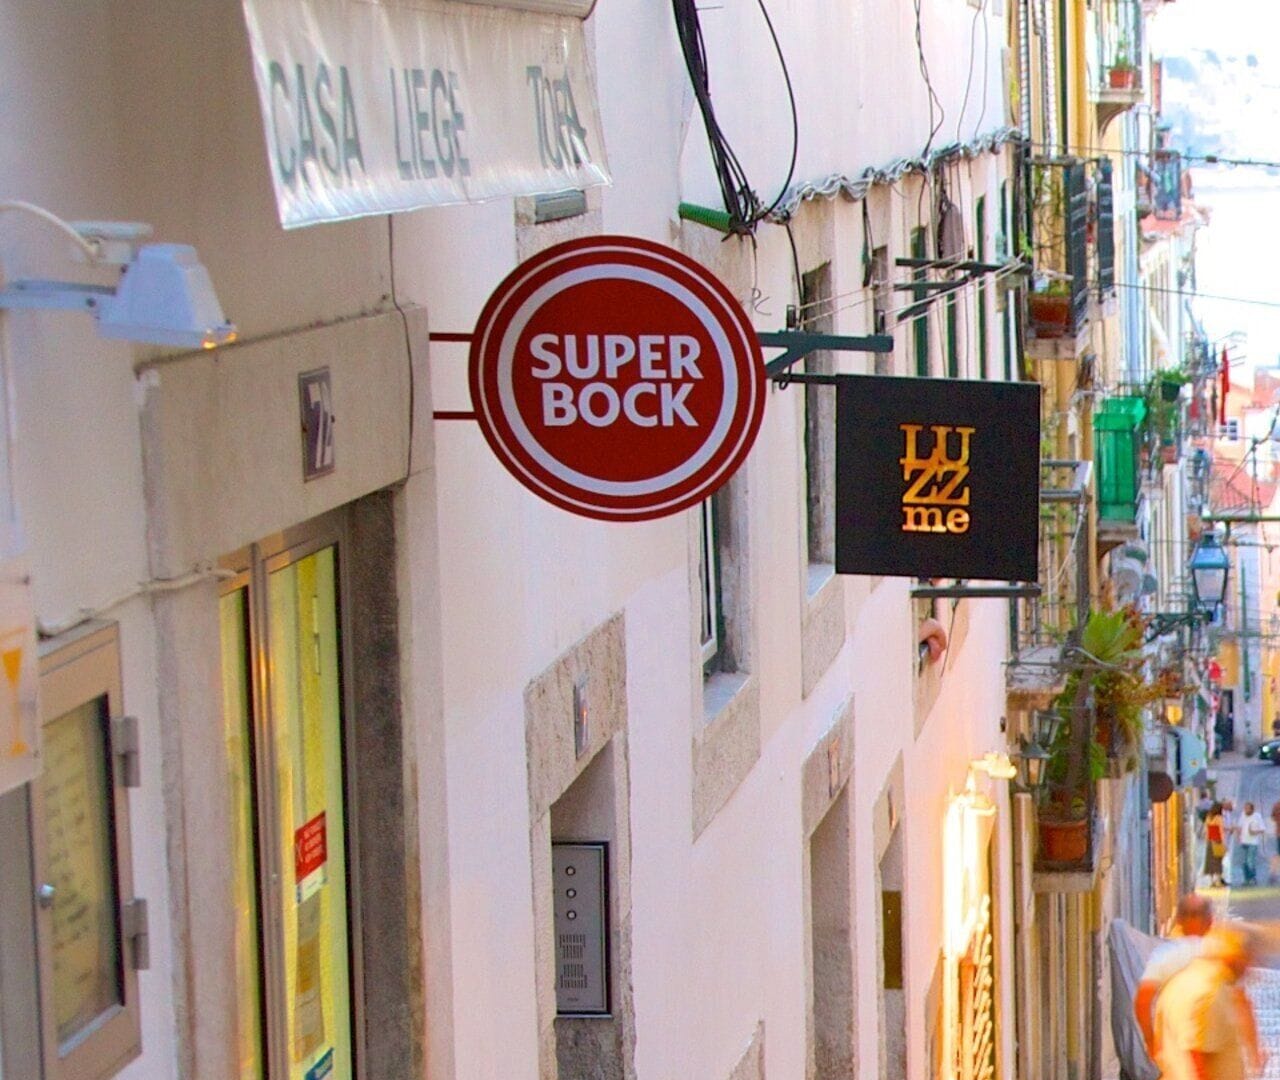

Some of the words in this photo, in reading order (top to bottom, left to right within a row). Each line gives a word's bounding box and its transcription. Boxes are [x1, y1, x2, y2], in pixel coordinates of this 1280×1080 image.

[269, 60, 366, 190] CASA
[389, 68, 471, 181] LIEGE
[530, 333, 704, 379] SUPER
[308, 380, 333, 469] 72
[541, 381, 699, 427] BOCK
[902, 506, 970, 533] me
